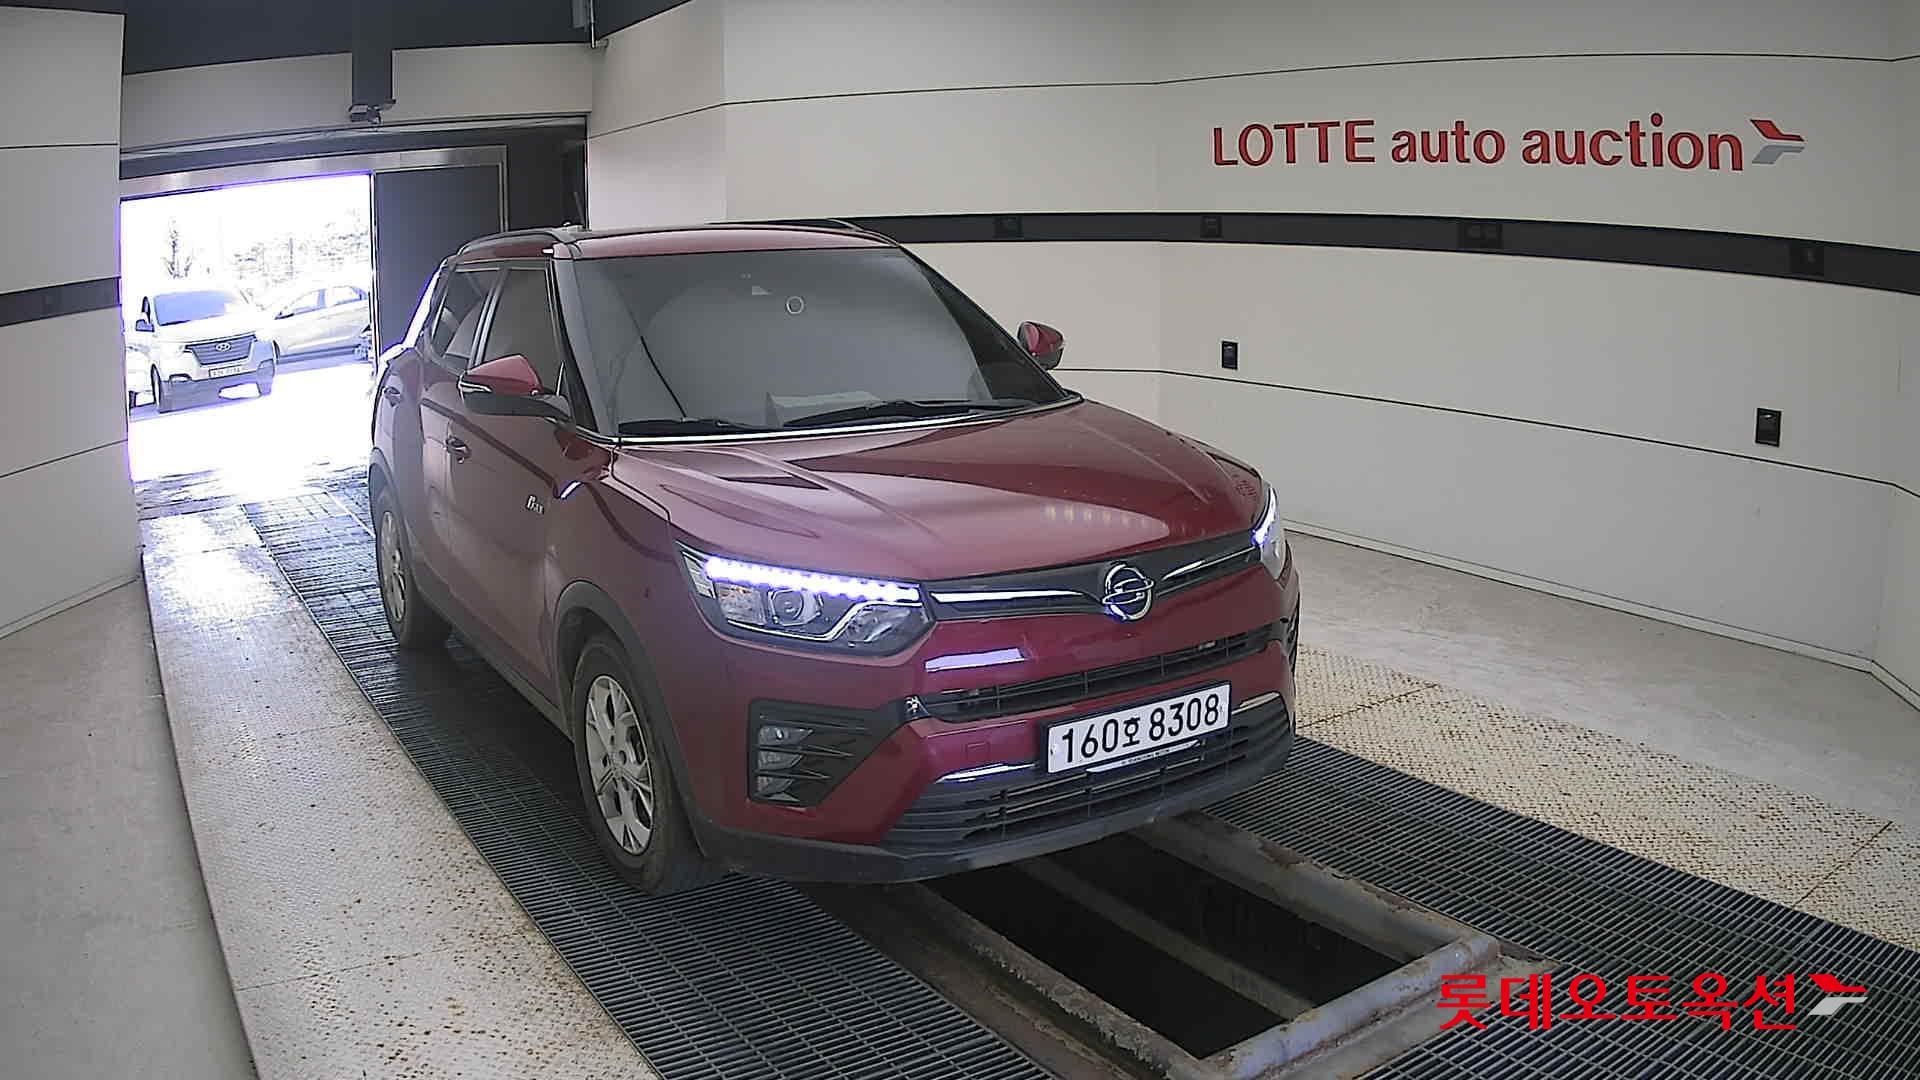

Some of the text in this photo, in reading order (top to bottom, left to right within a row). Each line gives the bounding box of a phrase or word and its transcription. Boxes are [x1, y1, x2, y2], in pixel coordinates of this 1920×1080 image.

[1213, 113, 1746, 172] LOTTE auto auction
[1061, 693, 1219, 764] 160호 8308
